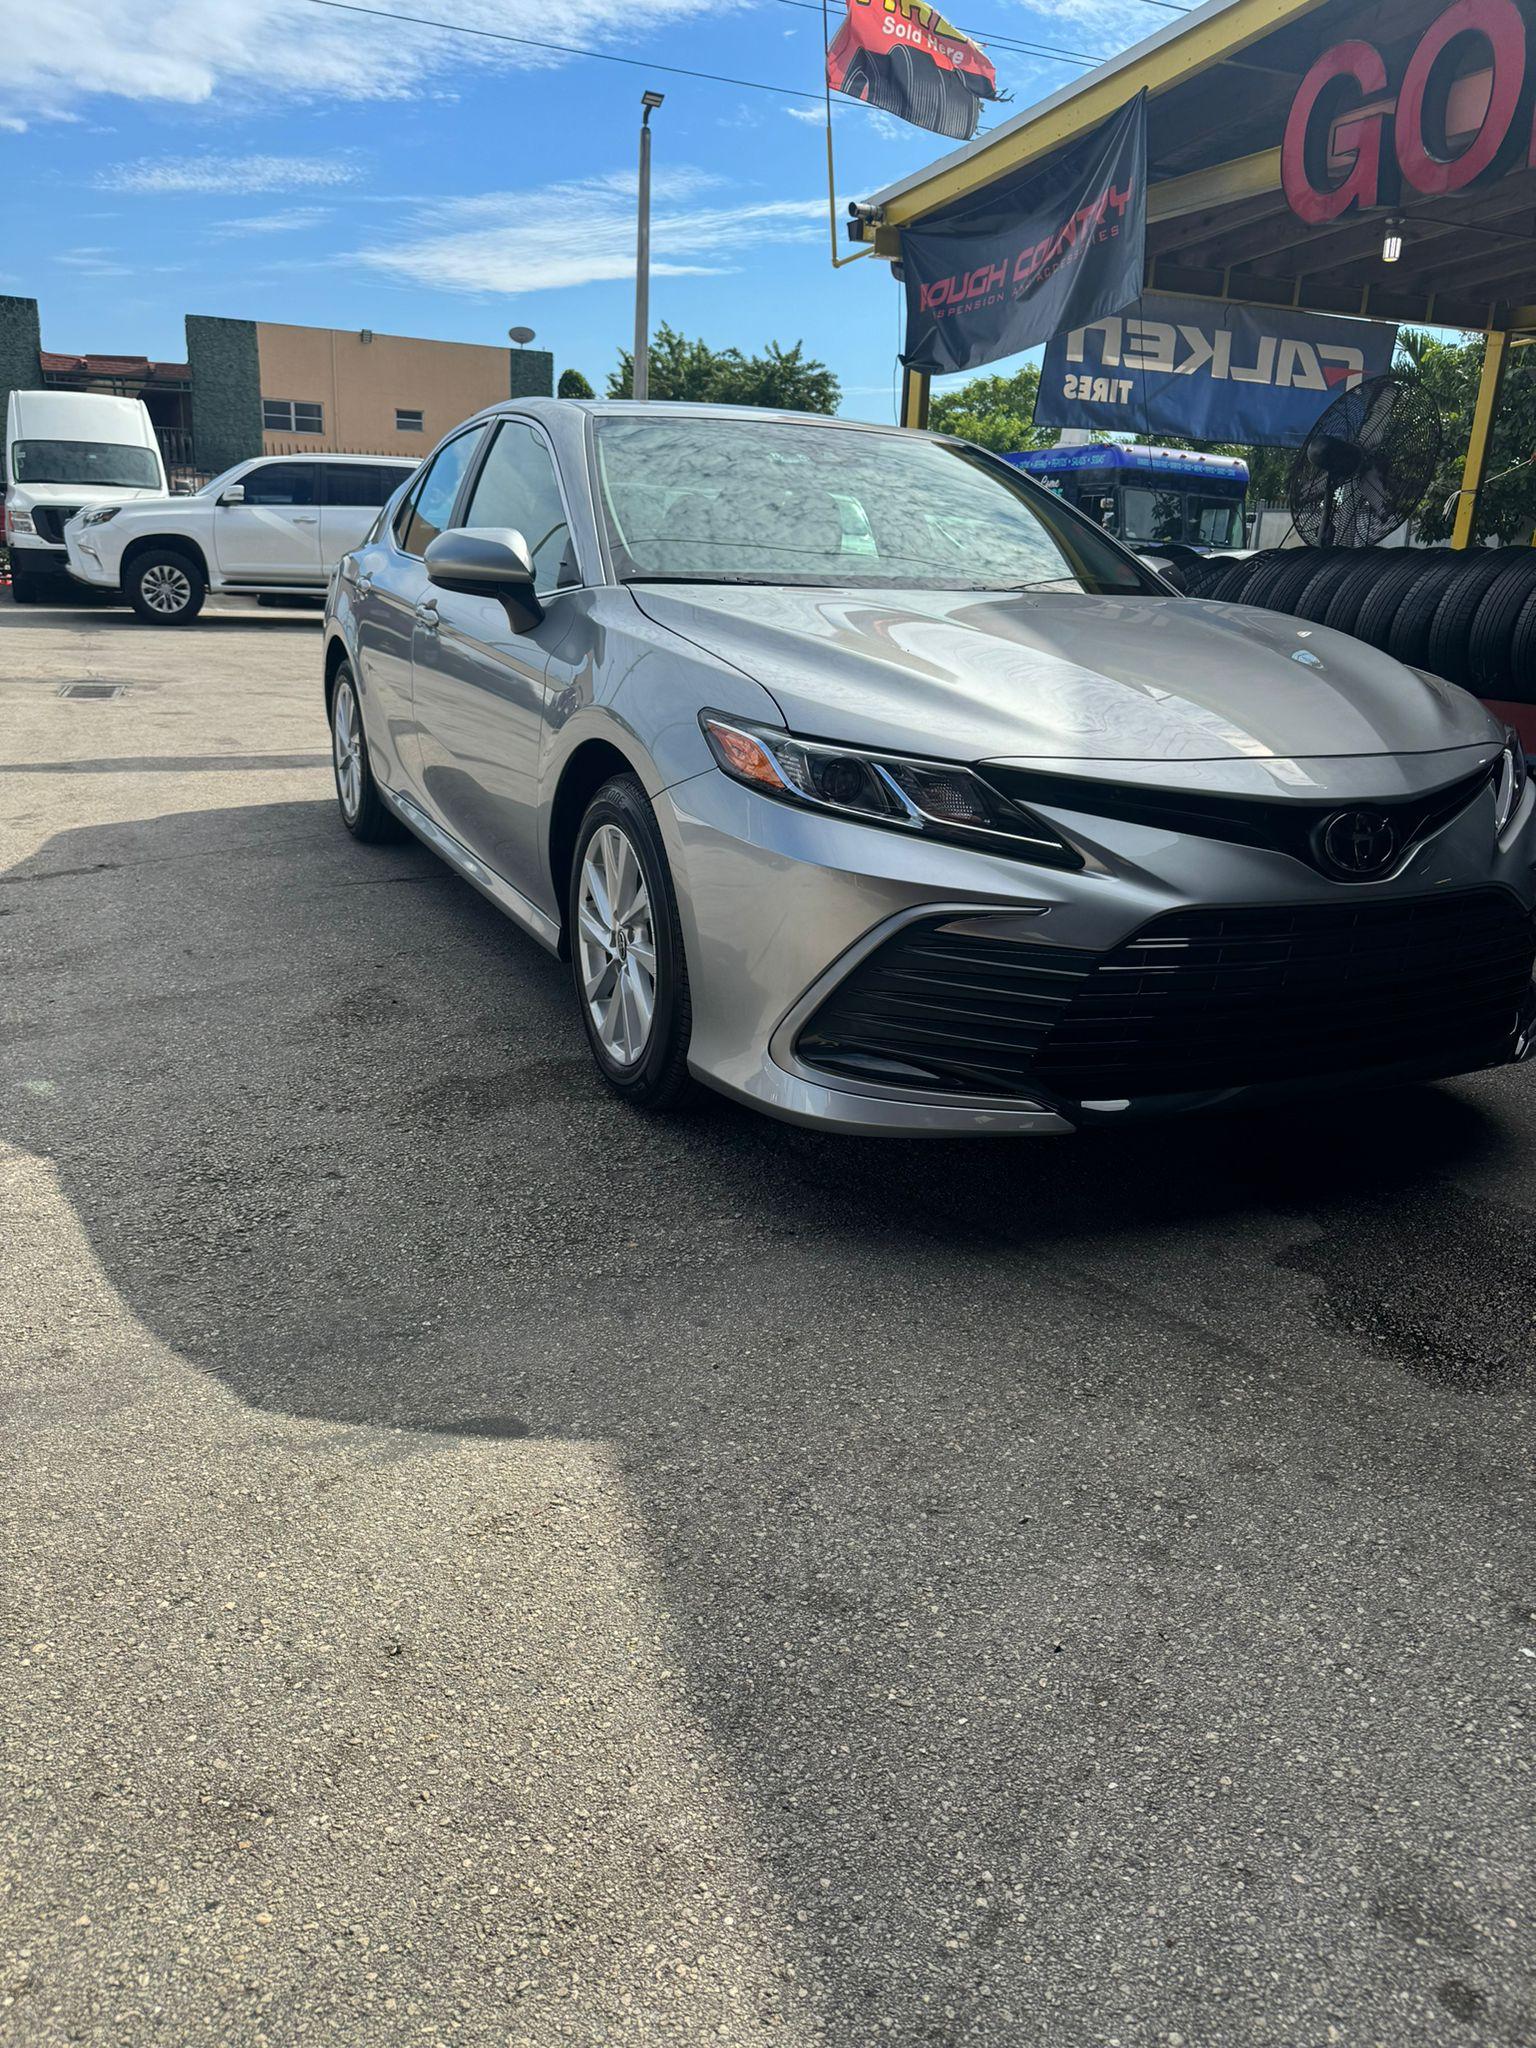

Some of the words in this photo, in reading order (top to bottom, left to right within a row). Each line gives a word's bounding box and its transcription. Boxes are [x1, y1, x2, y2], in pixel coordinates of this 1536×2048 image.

[882, 16, 922, 45] Sold
[927, 33, 964, 64] Here
[1281, 0, 1536, 224] GO
[932, 291, 1004, 320] SPENSION
